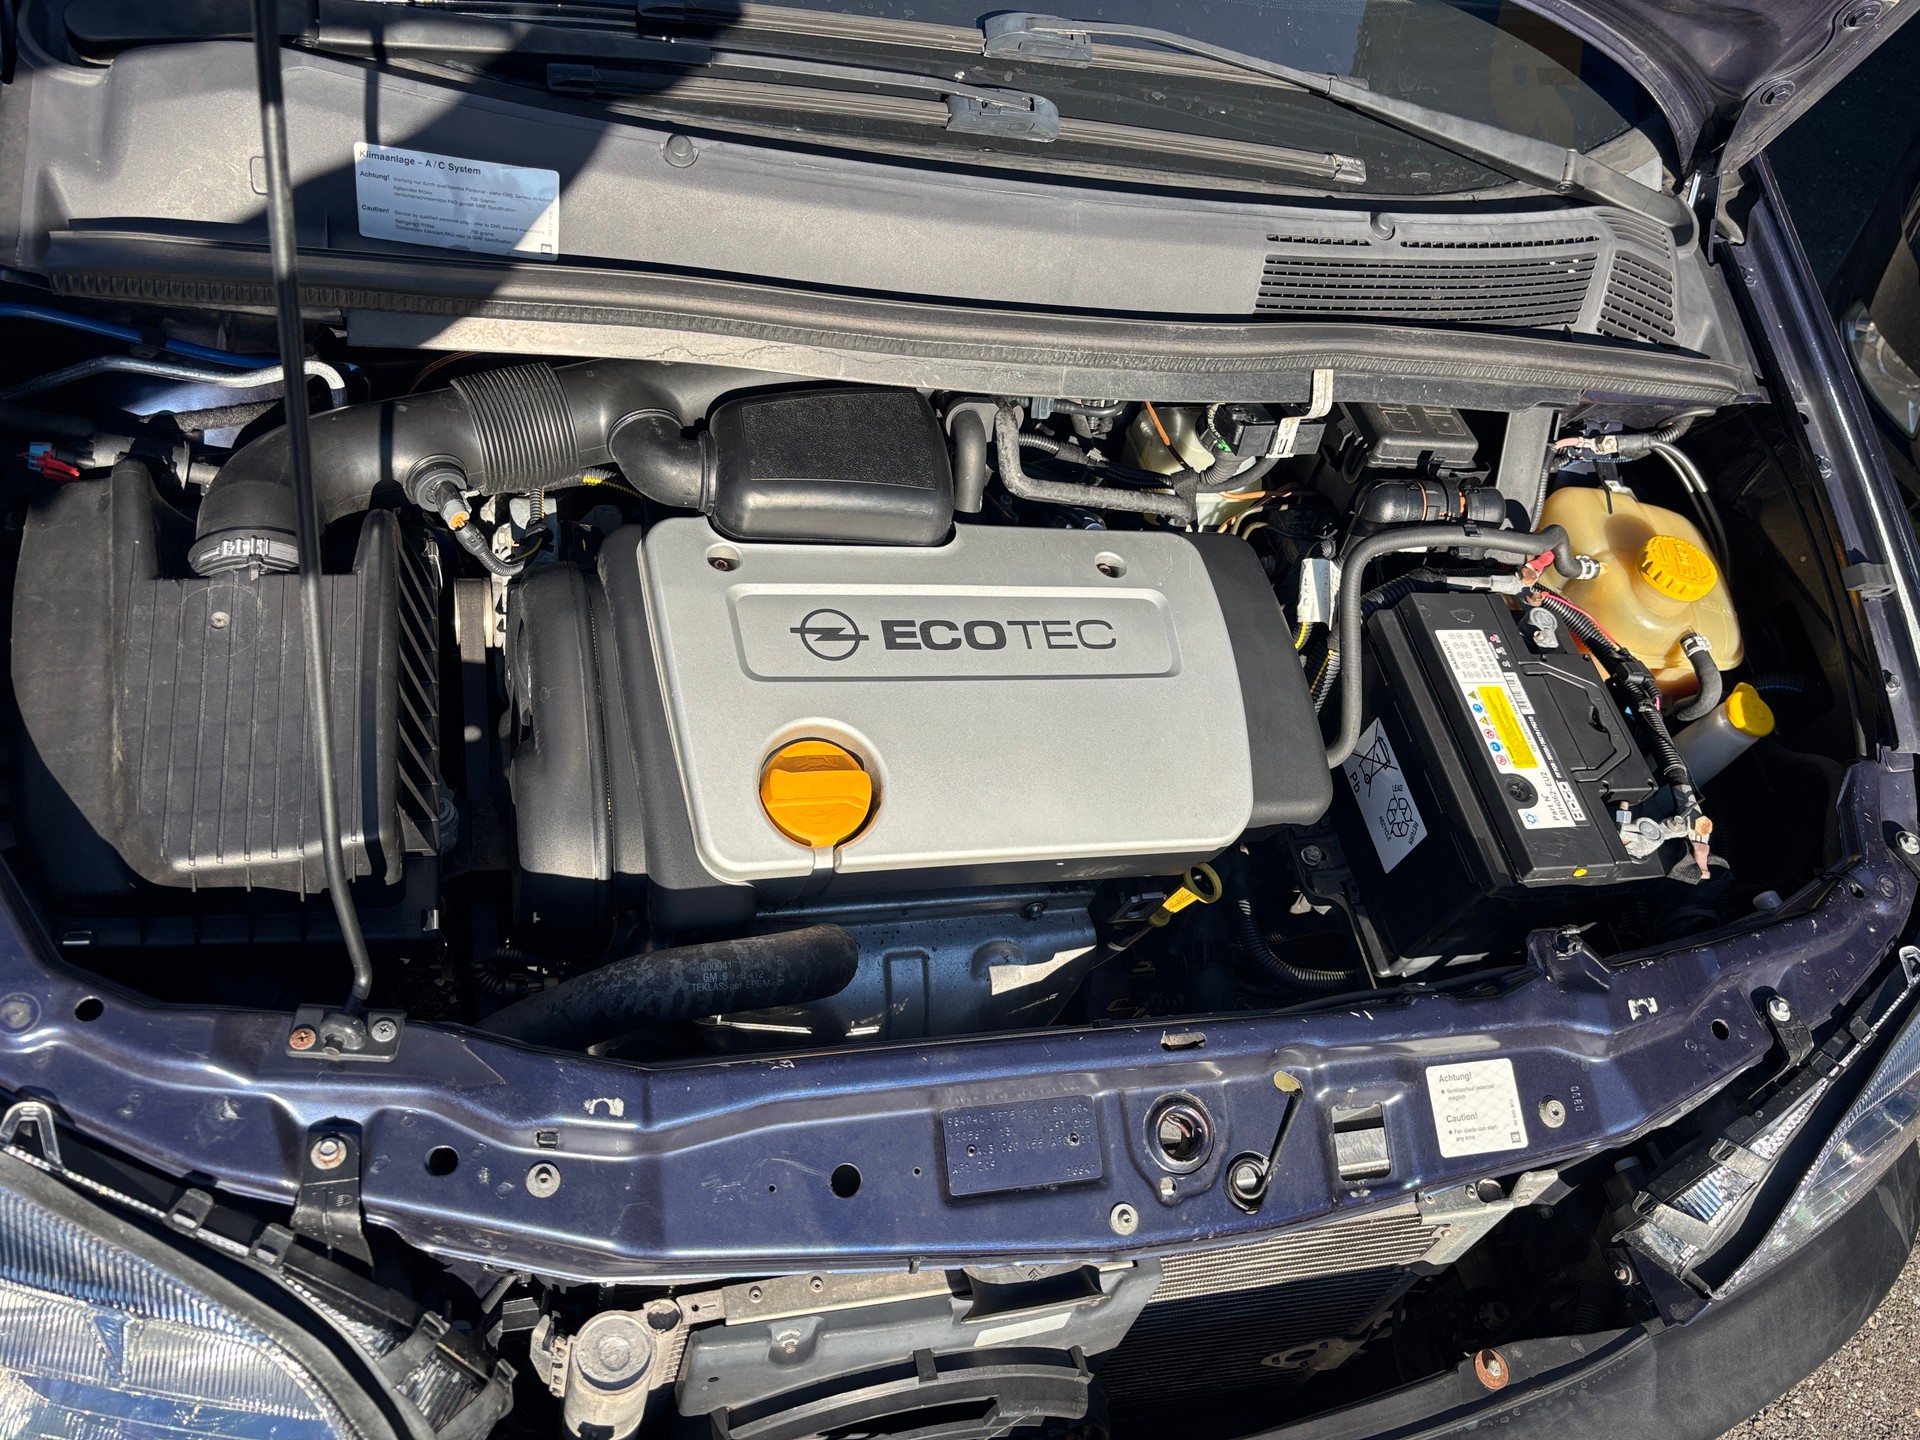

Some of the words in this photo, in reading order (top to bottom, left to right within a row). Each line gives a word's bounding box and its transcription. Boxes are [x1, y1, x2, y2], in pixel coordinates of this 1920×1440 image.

[359, 150, 415, 167] Klimaanlage
[448, 162, 481, 175] System
[359, 170, 390, 182] Achtung!
[361, 204, 390, 214] Caution!
[881, 619, 1117, 649] ECOTEC
[1442, 640, 1460, 670] WARRANTY
[1349, 770, 1361, 794] Pb
[1391, 784, 1404, 793] LEAD
[1540, 771, 1569, 821] ABH062-EU2
[1548, 804, 1560, 821] Part
[1378, 815, 1392, 843] RECYCLE
[1408, 821, 1420, 847] RETURN
[1438, 1072, 1473, 1083] Achtung!
[1446, 1112, 1478, 1123] Caution!
